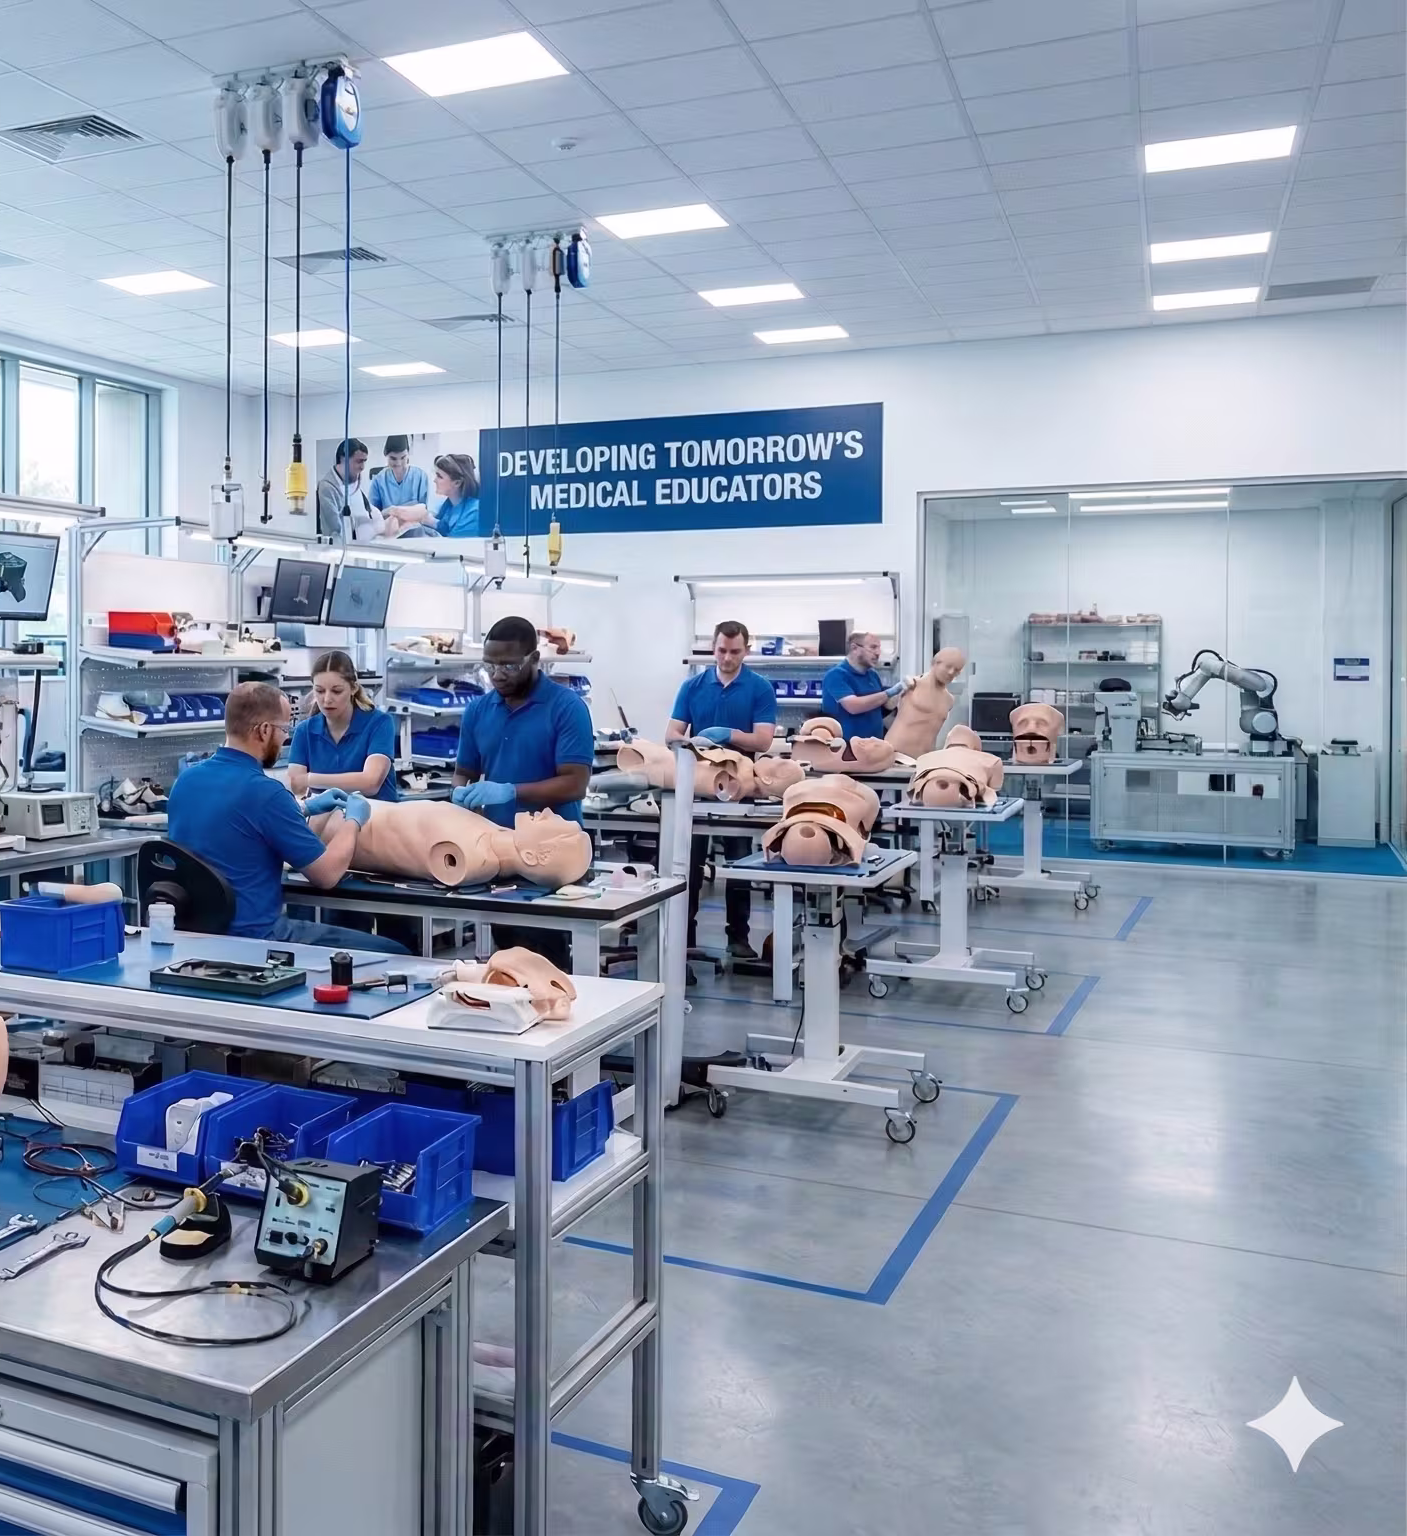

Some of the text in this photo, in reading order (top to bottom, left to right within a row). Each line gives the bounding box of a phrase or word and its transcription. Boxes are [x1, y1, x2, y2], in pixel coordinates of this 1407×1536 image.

[499, 430, 864, 476] DEVELOPING TOMORROW'S
[530, 471, 823, 510] MEDICAL EDUCATORS
